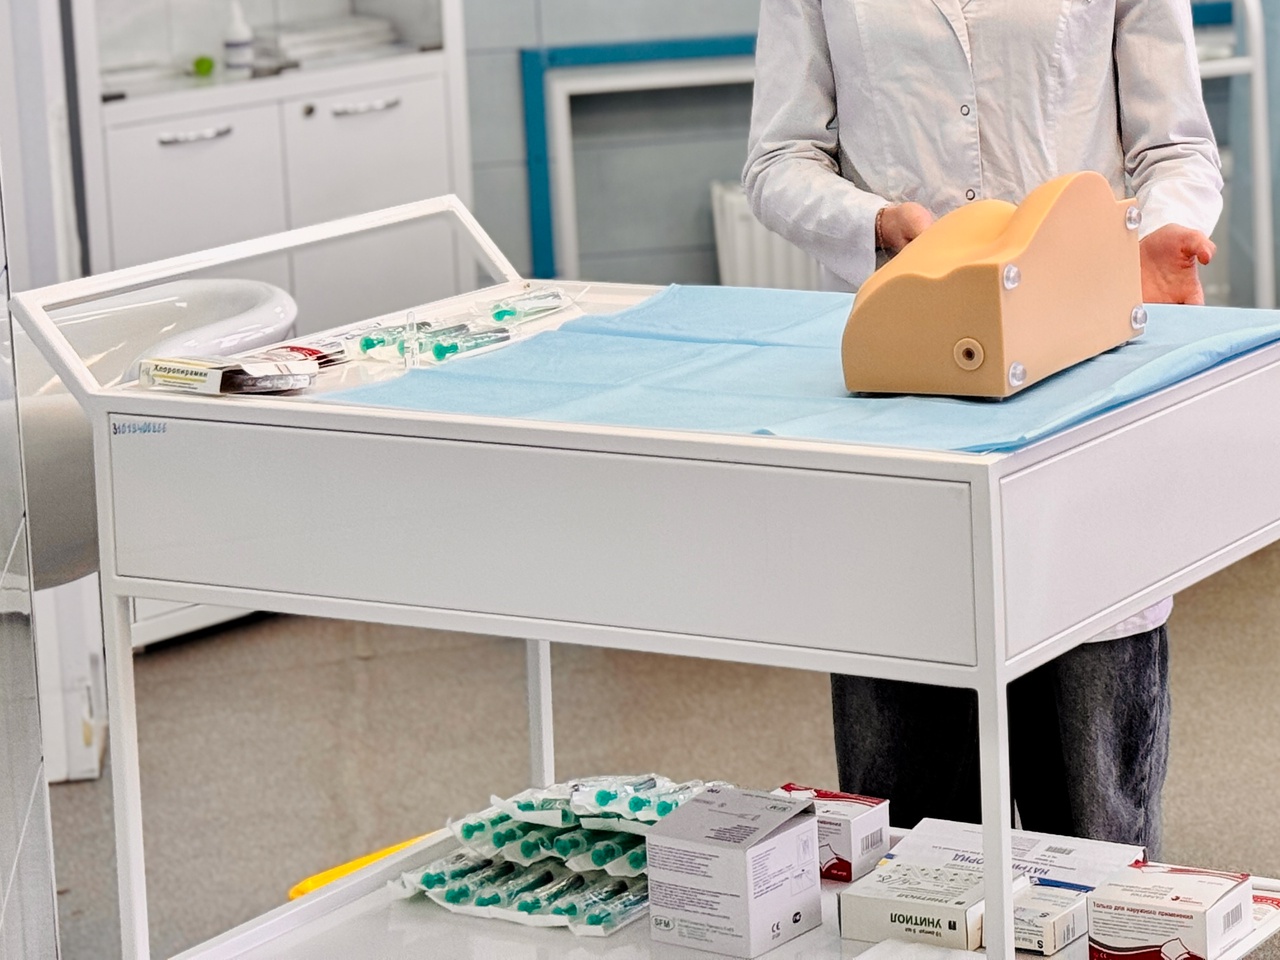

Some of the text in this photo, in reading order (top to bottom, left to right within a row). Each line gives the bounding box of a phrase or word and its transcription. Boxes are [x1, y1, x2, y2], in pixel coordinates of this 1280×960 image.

[153, 364, 208, 377] Хлоропирамин
[1093, 901, 1113, 910] Только
[654, 918, 671, 929] SFM
[890, 912, 942, 929] УНИТИОЛ
